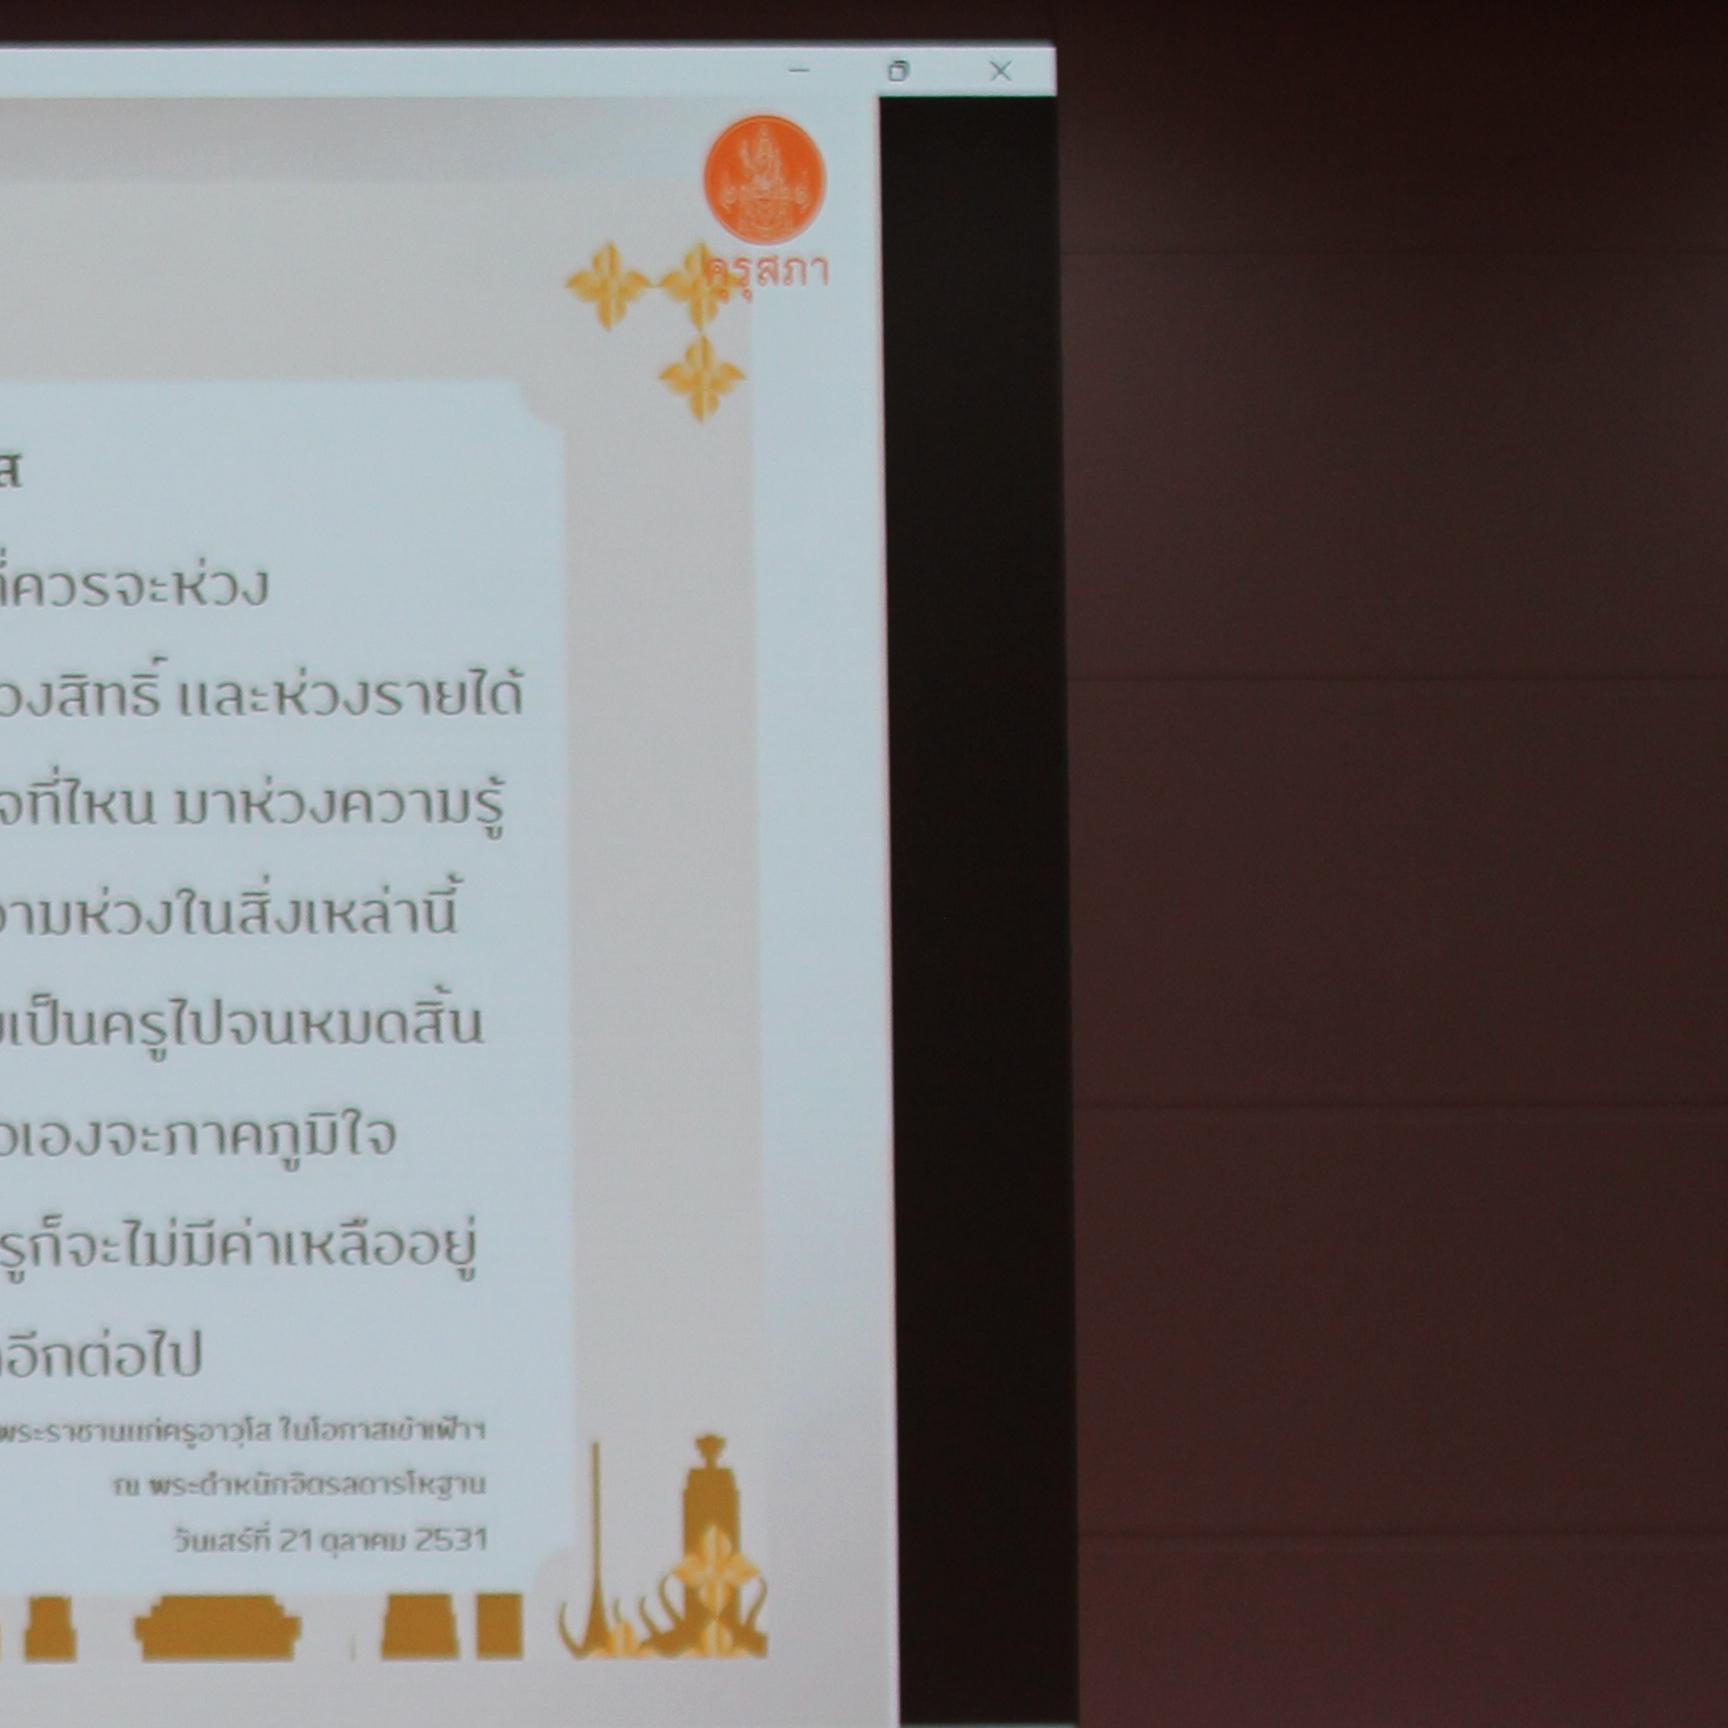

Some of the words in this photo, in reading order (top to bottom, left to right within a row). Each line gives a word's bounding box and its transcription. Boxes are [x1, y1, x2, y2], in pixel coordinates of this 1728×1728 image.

[706, 254, 830, 304] คุรุสภา
[179, 666, 524, 717] และห่วงรายได้
[175, 775, 506, 841] มาห่วงความรู้
[280, 1527, 312, 1552] 21
[319, 1532, 407, 1559] ตุลาคม
[415, 1526, 487, 1552] 2531
